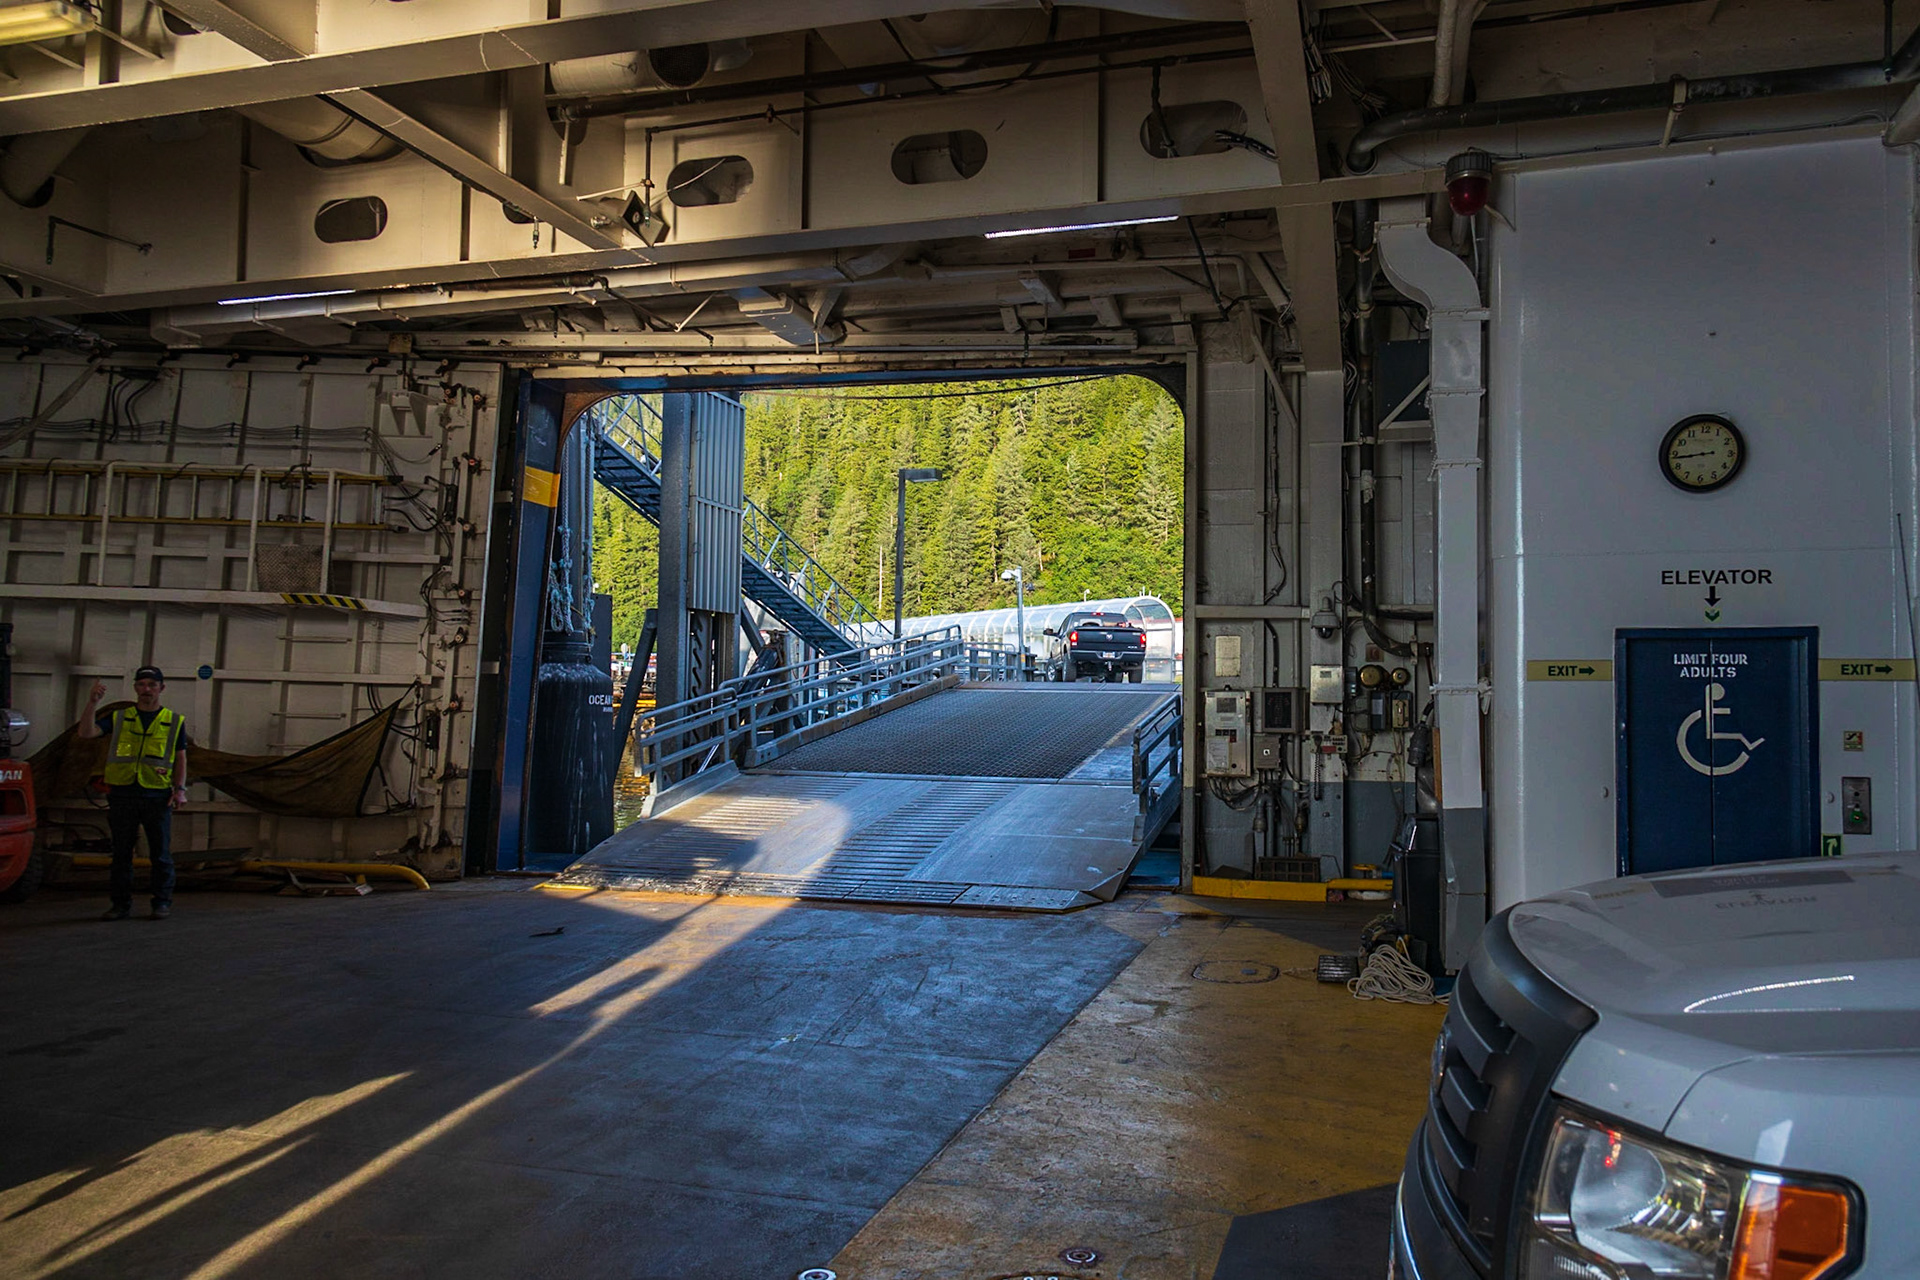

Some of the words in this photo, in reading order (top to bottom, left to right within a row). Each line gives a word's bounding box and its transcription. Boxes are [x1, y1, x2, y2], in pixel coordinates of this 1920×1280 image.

[1675, 462, 1681, 470] 8
[1684, 471, 1690, 479] 7
[1697, 474, 1703, 482] 6
[1711, 471, 1717, 479] 5
[1661, 569, 1773, 585] ELEVATOR
[1673, 653, 1707, 665] LIMIT
[1711, 653, 1748, 665] FOUR
[1548, 665, 1578, 677] EXIT
[1680, 666, 1737, 678] ADULTS
[1841, 664, 1874, 676] EXIT
